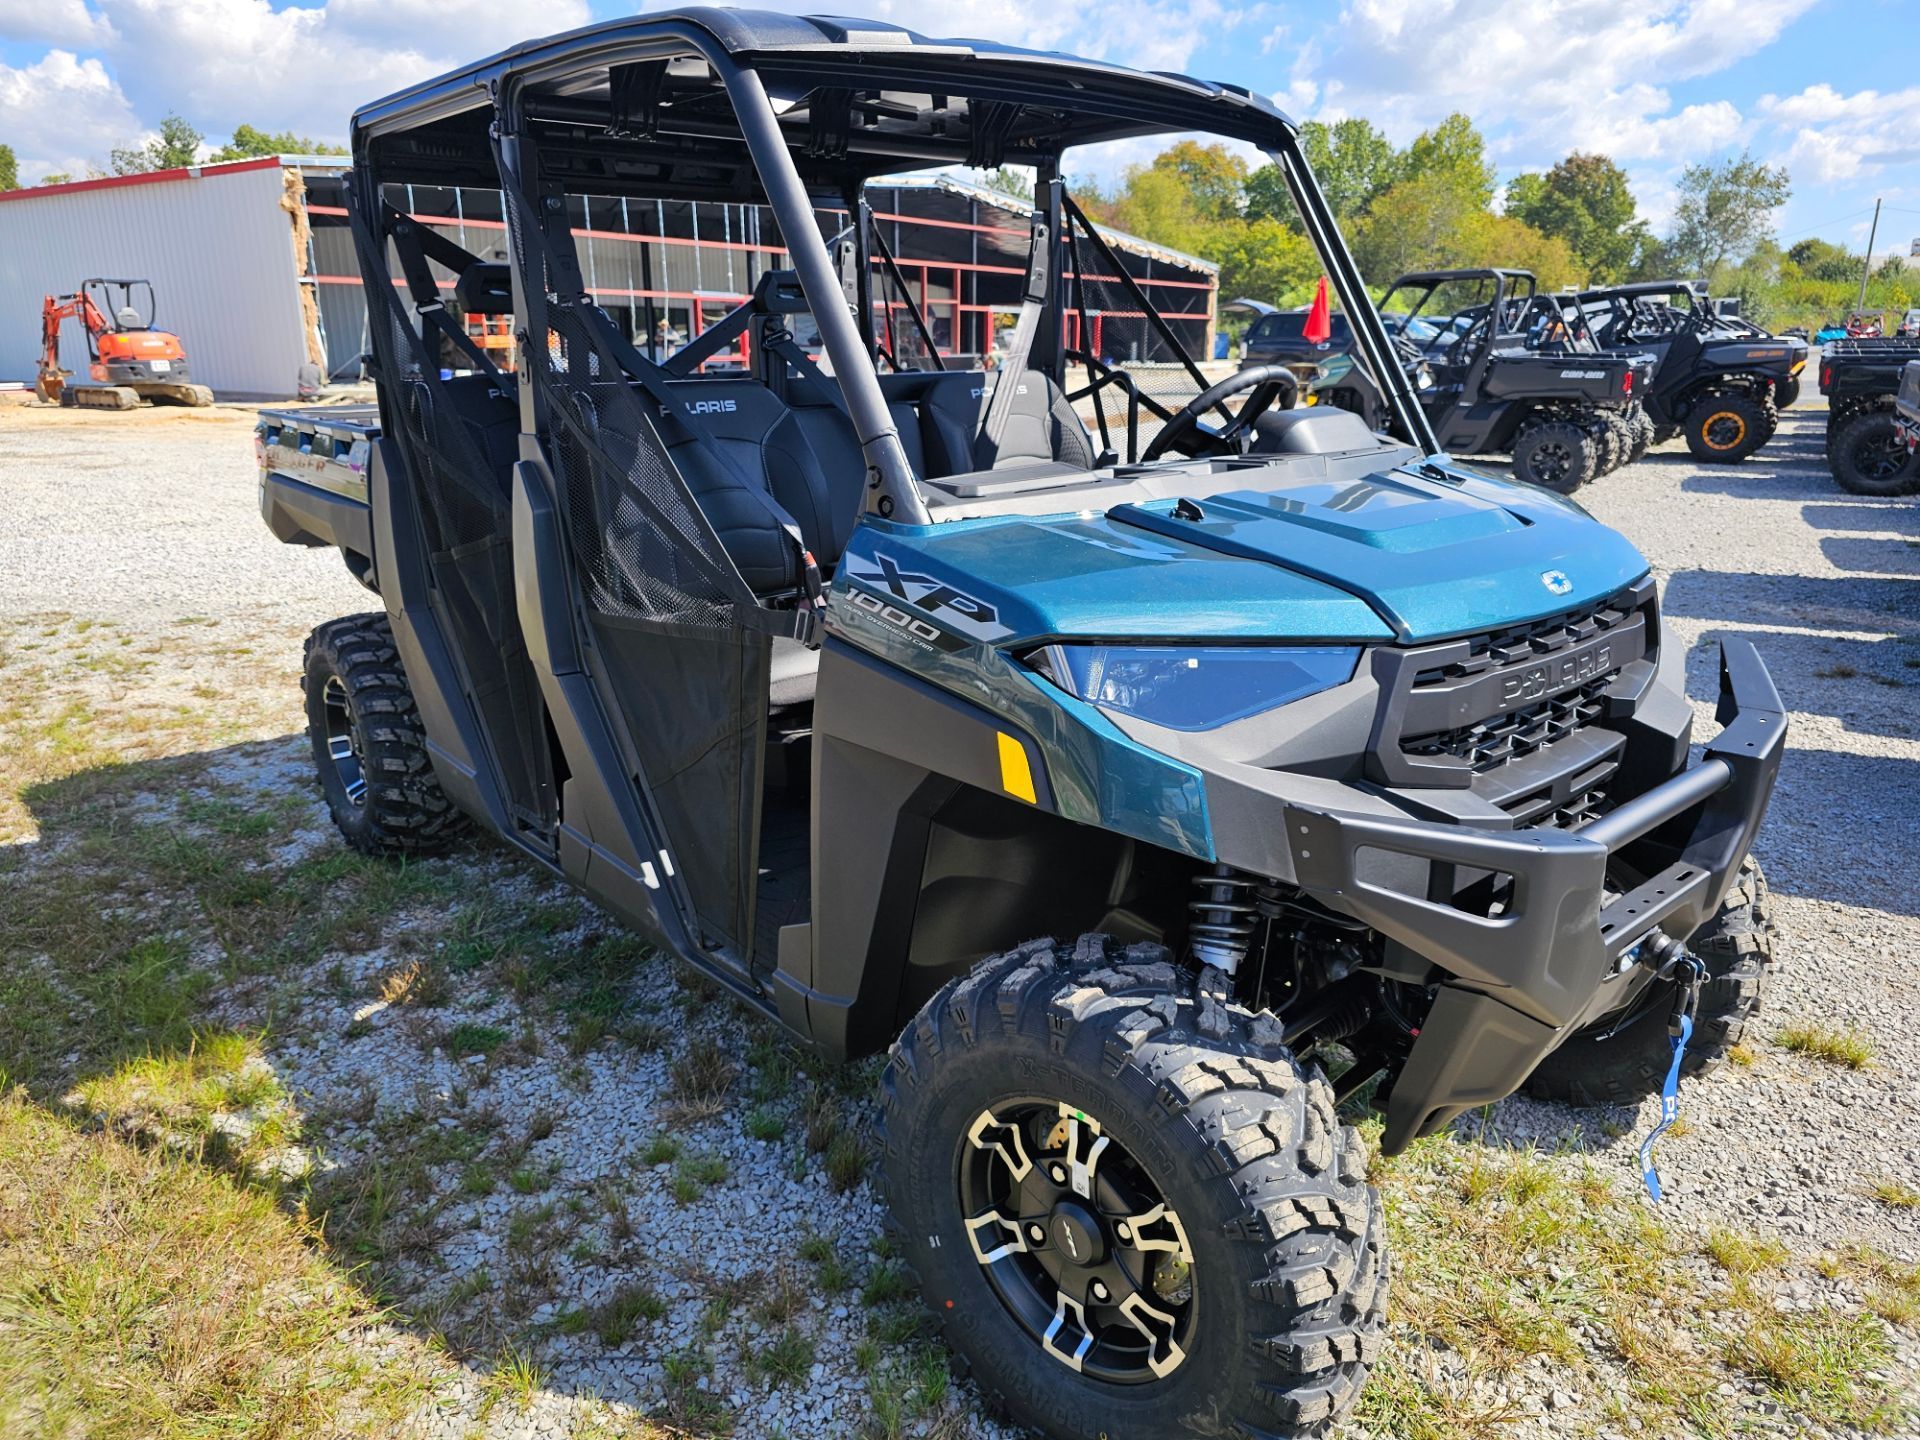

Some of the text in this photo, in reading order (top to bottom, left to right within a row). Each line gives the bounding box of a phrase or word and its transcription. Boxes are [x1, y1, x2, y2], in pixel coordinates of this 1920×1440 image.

[658, 399, 737, 417] PLARIS
[848, 551, 998, 623] XP
[843, 604, 934, 652] DUAL OVERHEAD CAM
[845, 588, 941, 641] 1000
[1499, 642, 1612, 708] POLARIS
